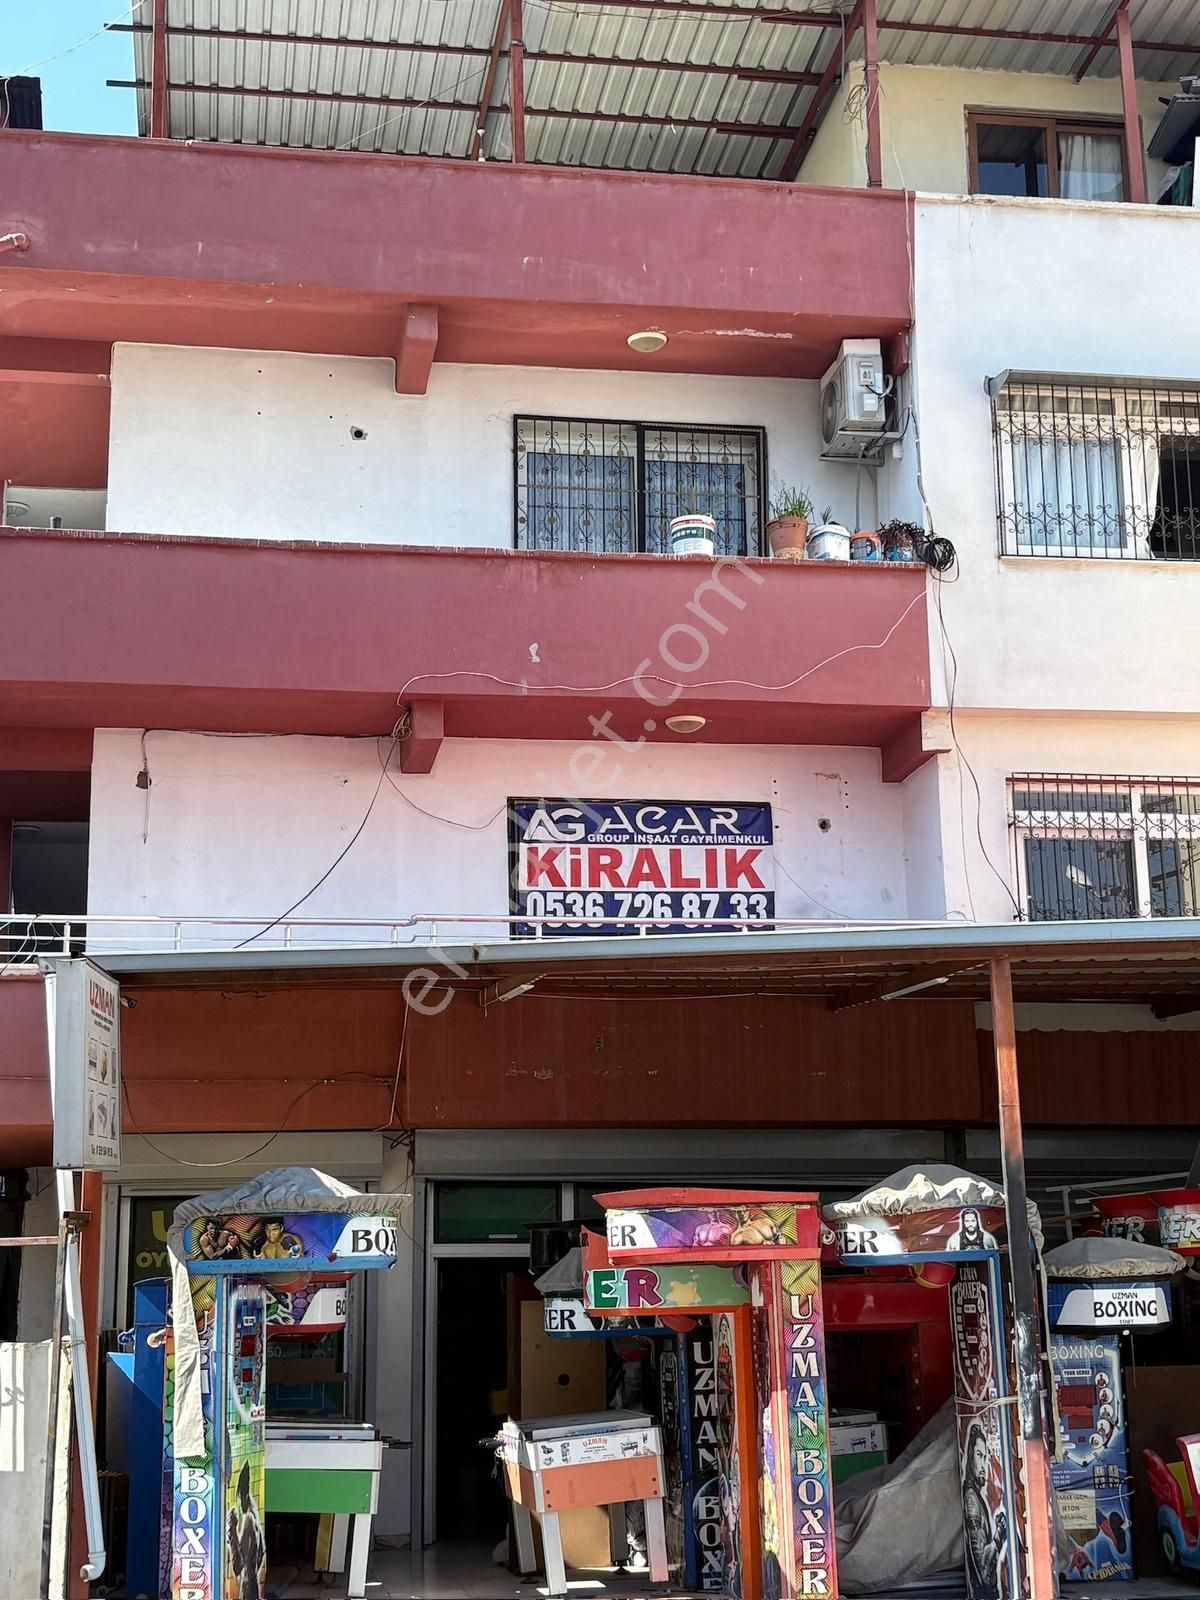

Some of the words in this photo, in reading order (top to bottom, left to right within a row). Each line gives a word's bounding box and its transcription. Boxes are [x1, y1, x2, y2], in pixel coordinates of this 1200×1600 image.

[522, 807, 585, 841] AG
[596, 806, 741, 834] ACAR
[587, 833, 630, 843] GROUP
[526, 892, 604, 928] 0536
[614, 892, 673, 928] 726
[681, 893, 720, 928] 87
[729, 894, 767, 928] 33
[89, 978, 115, 1018] UZMAN
[608, 1225, 637, 1248] ER
[135, 1250, 172, 1269] OY
[582, 1267, 664, 1308] ER
[1093, 1299, 1158, 1318] BOXING
[791, 1295, 819, 1438] UZMAN
[796, 1448, 829, 1595] BOXER
